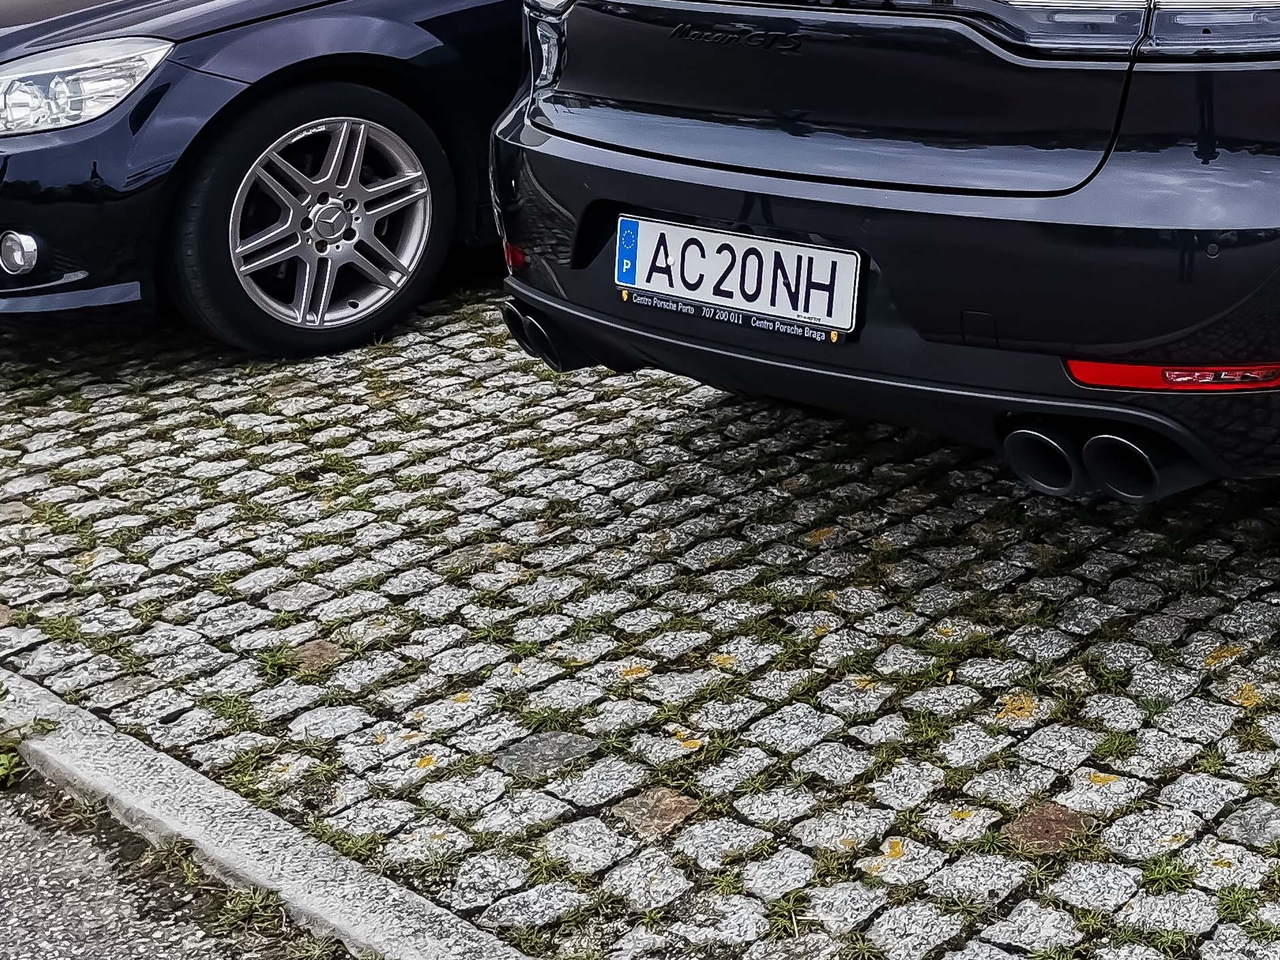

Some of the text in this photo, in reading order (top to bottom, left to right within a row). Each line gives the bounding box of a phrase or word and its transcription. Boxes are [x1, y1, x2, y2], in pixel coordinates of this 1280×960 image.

[669, 23, 808, 51] Macan GTS
[622, 259, 631, 273] P
[645, 232, 838, 318] AC20NH
[632, 293, 826, 341] Centro Porsche Porto 707 200 011 Centro Porsche Braga
